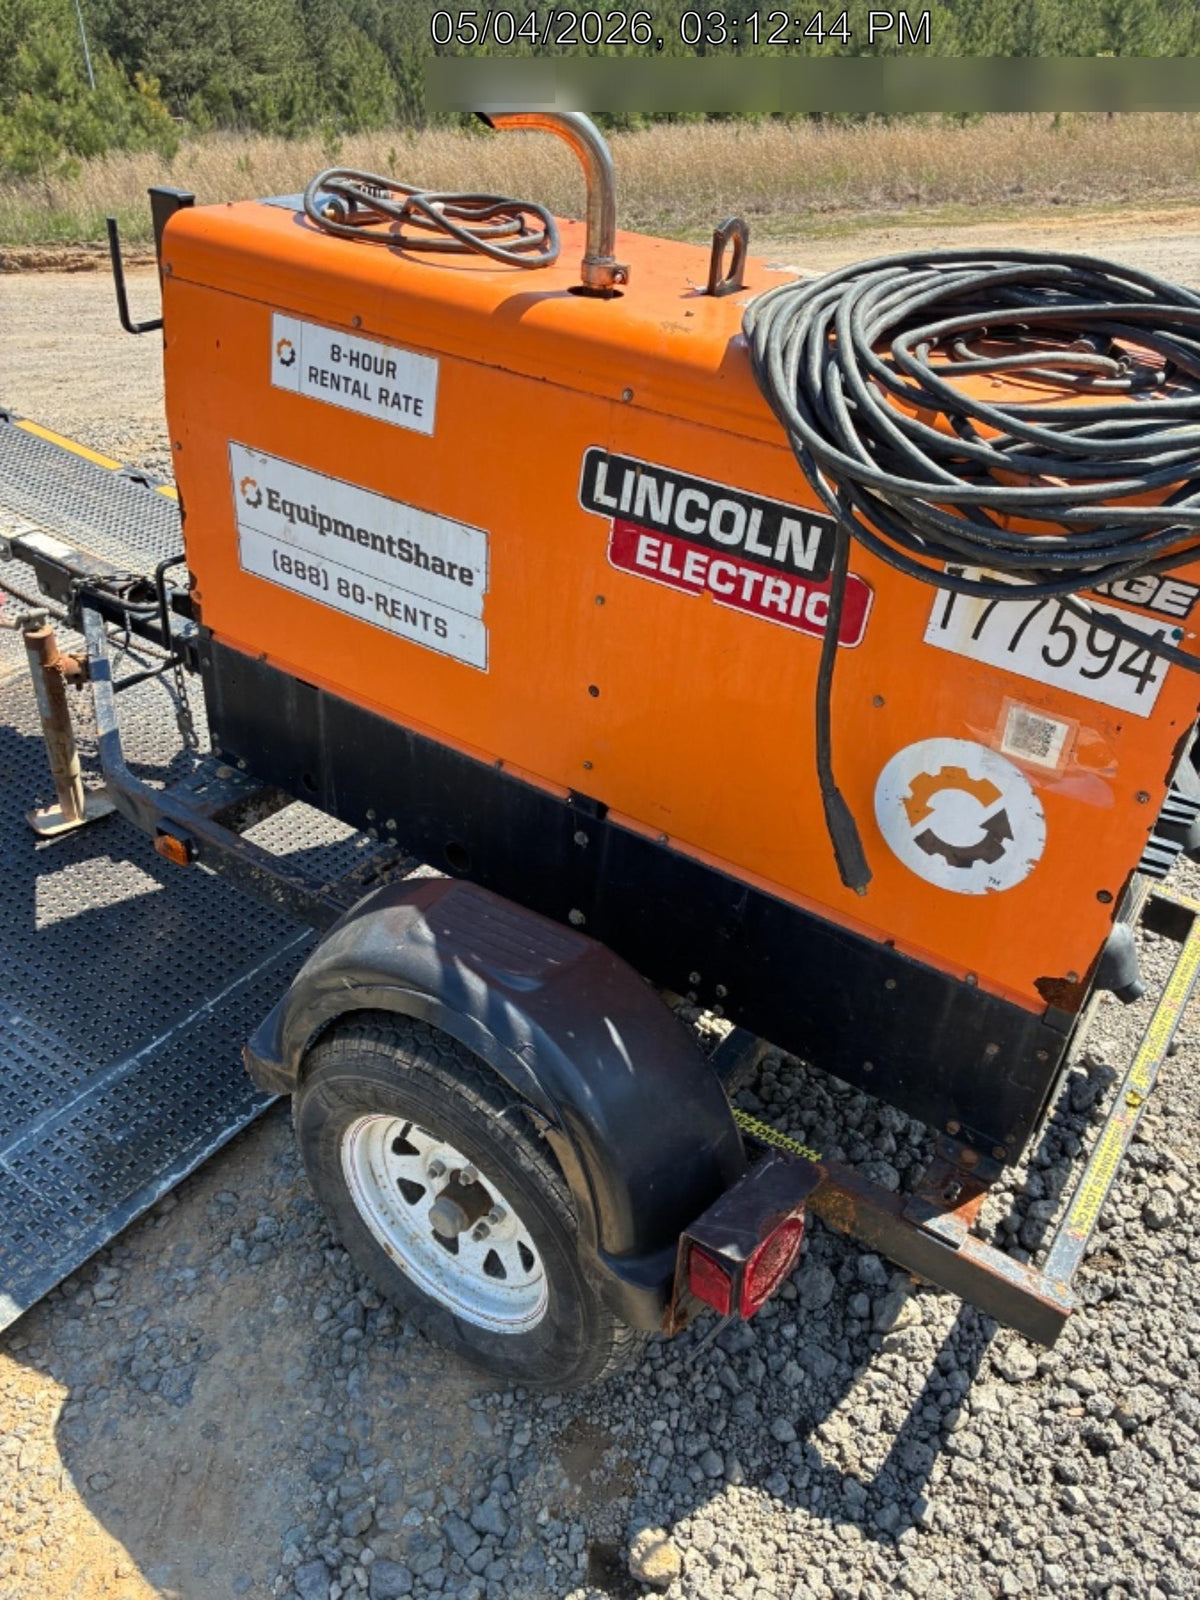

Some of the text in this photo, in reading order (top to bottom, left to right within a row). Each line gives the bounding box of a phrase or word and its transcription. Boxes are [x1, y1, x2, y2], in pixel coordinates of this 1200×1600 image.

[308, 366, 424, 417] RENTAL RATE
[330, 343, 397, 380] 8-HOUR
[265, 487, 474, 587] EquipmentShare
[592, 461, 822, 572] LINCOLN
[272, 549, 448, 639] (888) 80-RENTS
[635, 534, 832, 628] ELECTRIC
[1090, 1151, 1114, 1187] STAND
